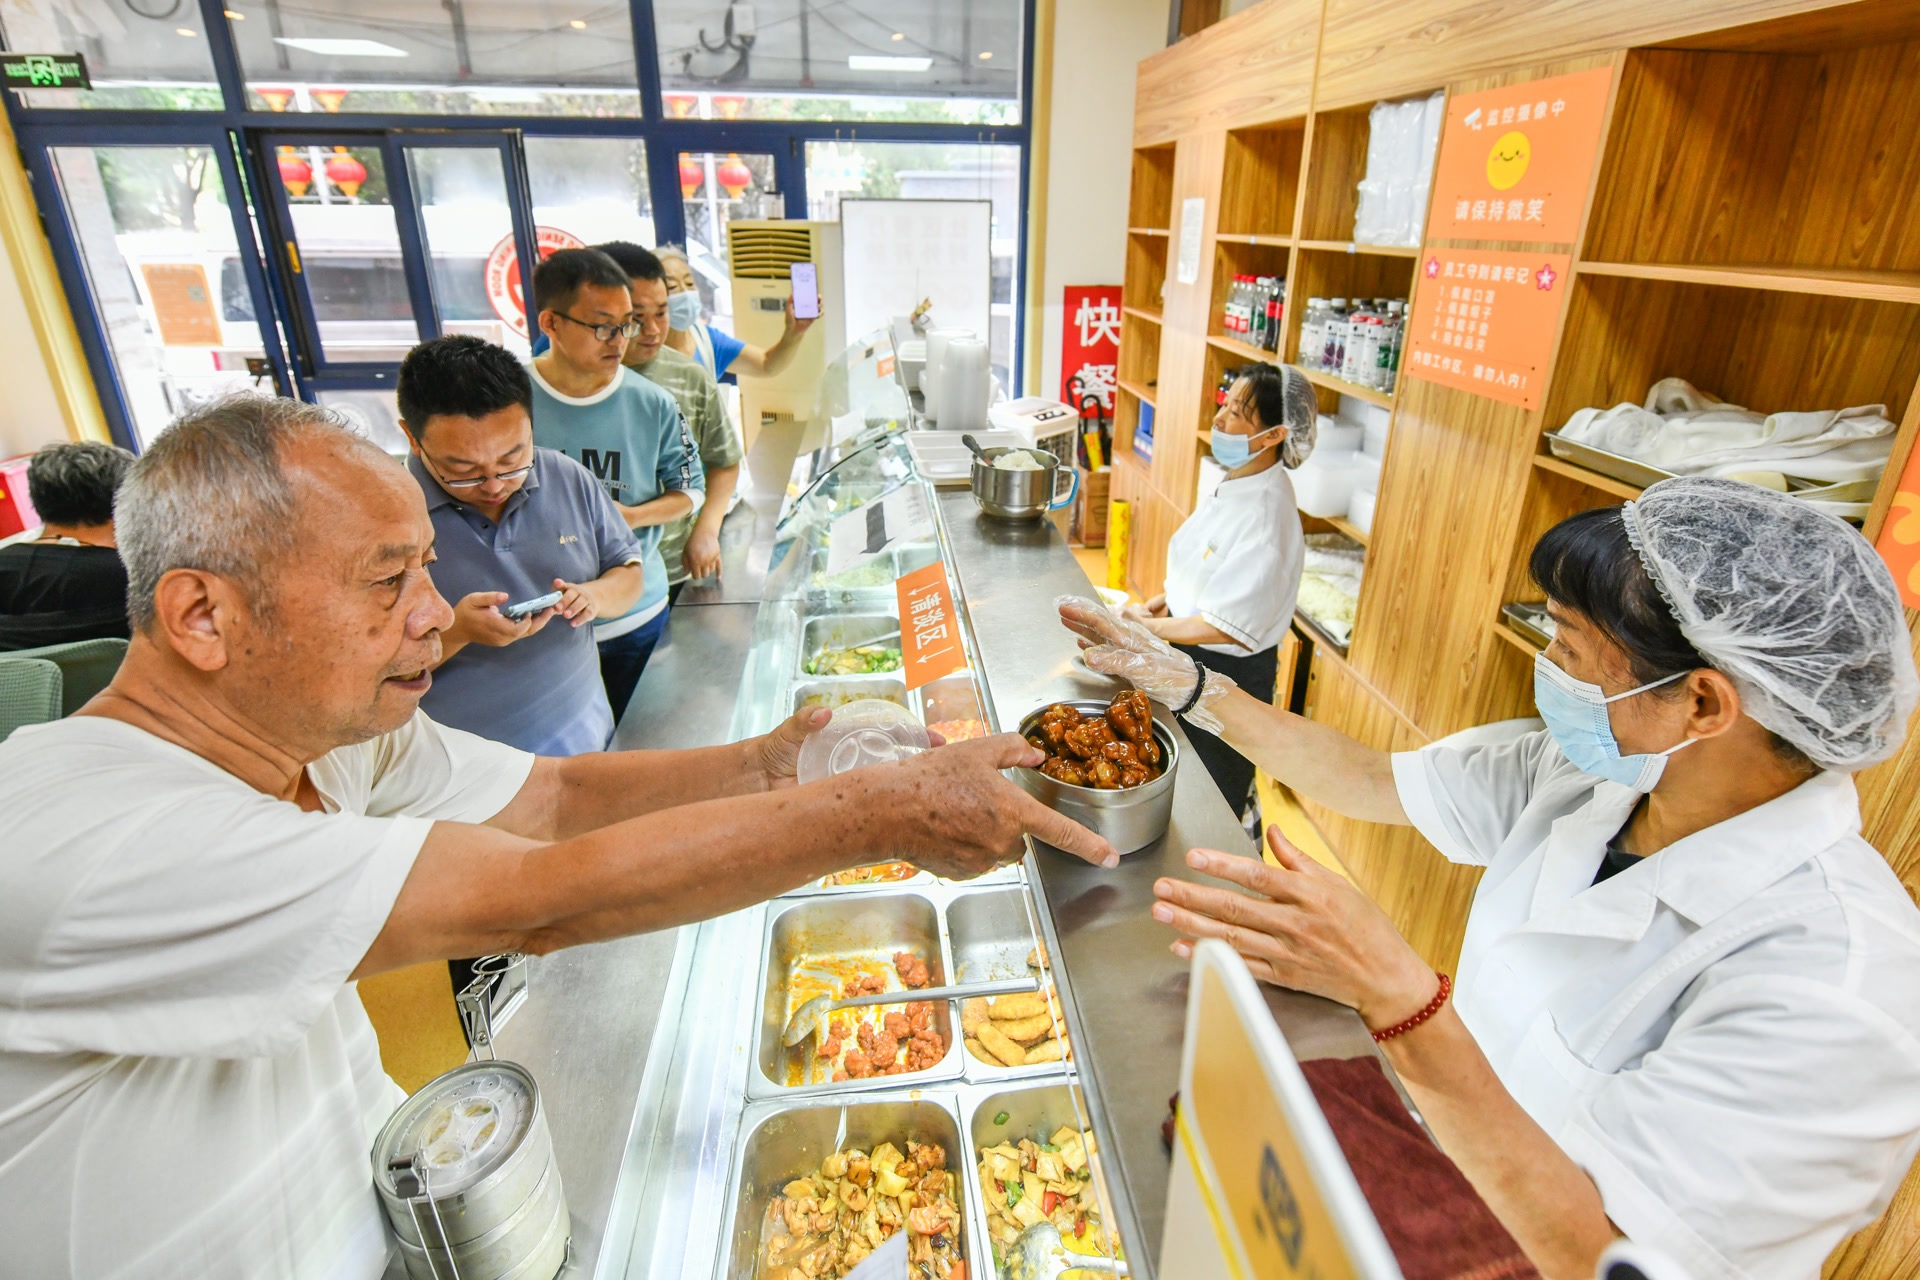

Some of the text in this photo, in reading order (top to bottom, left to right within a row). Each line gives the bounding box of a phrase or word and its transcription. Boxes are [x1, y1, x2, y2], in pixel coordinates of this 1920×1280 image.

[1486, 98, 1566, 127] 监控摄像中
[1455, 198, 1545, 222] 请保持微笑
[1444, 261, 1529, 284] 员工守则请牢记
[1073, 296, 1122, 410] 快餐
[910, 592, 948, 650] 清淡区
